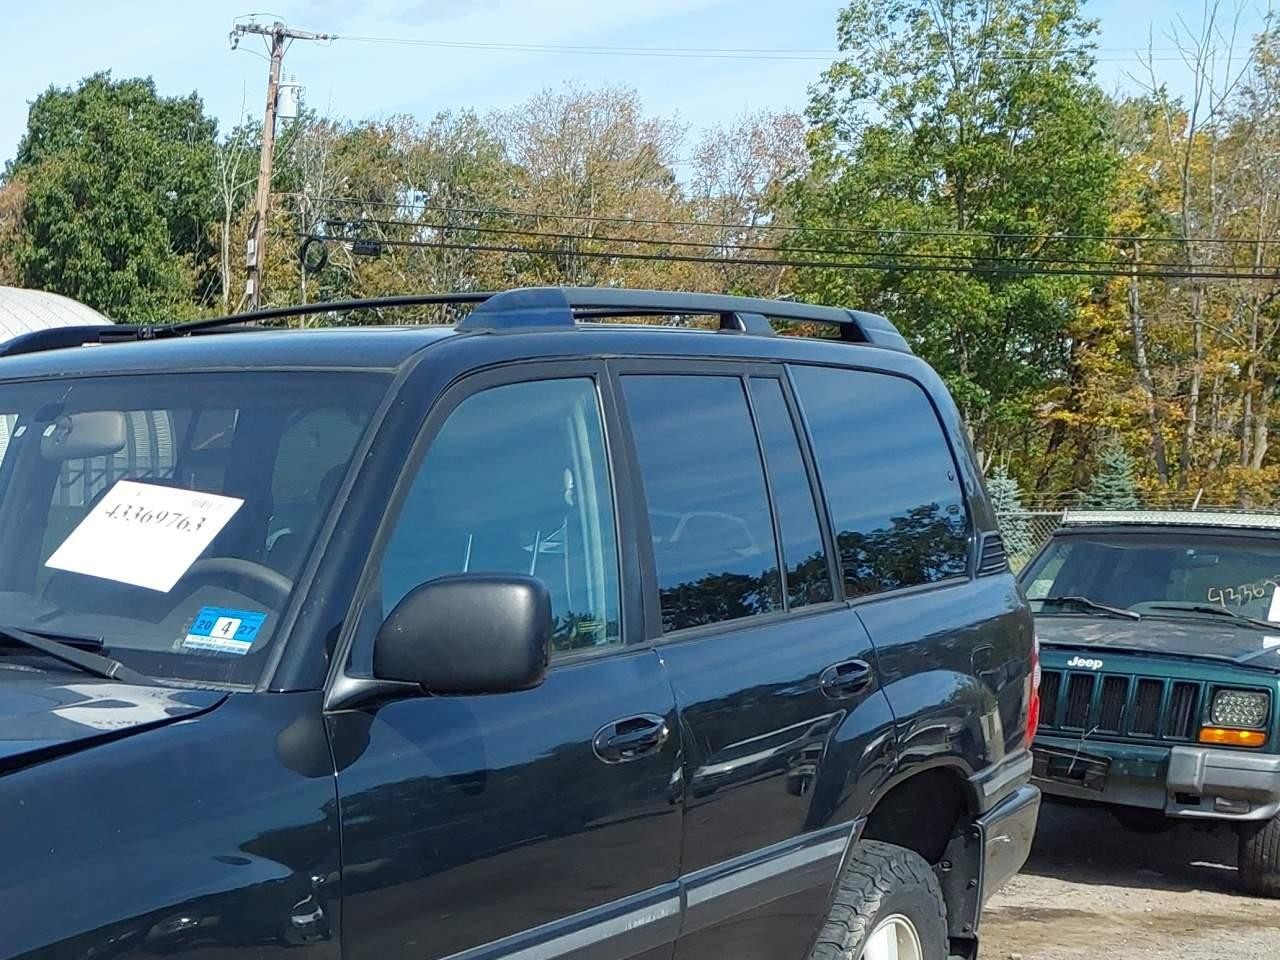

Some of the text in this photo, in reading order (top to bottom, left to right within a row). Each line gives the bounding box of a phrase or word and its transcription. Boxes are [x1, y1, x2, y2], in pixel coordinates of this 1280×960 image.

[105, 503, 207, 532] 43369763
[197, 620, 256, 636] 20 4 27
[1067, 656, 1103, 670] Jeep
